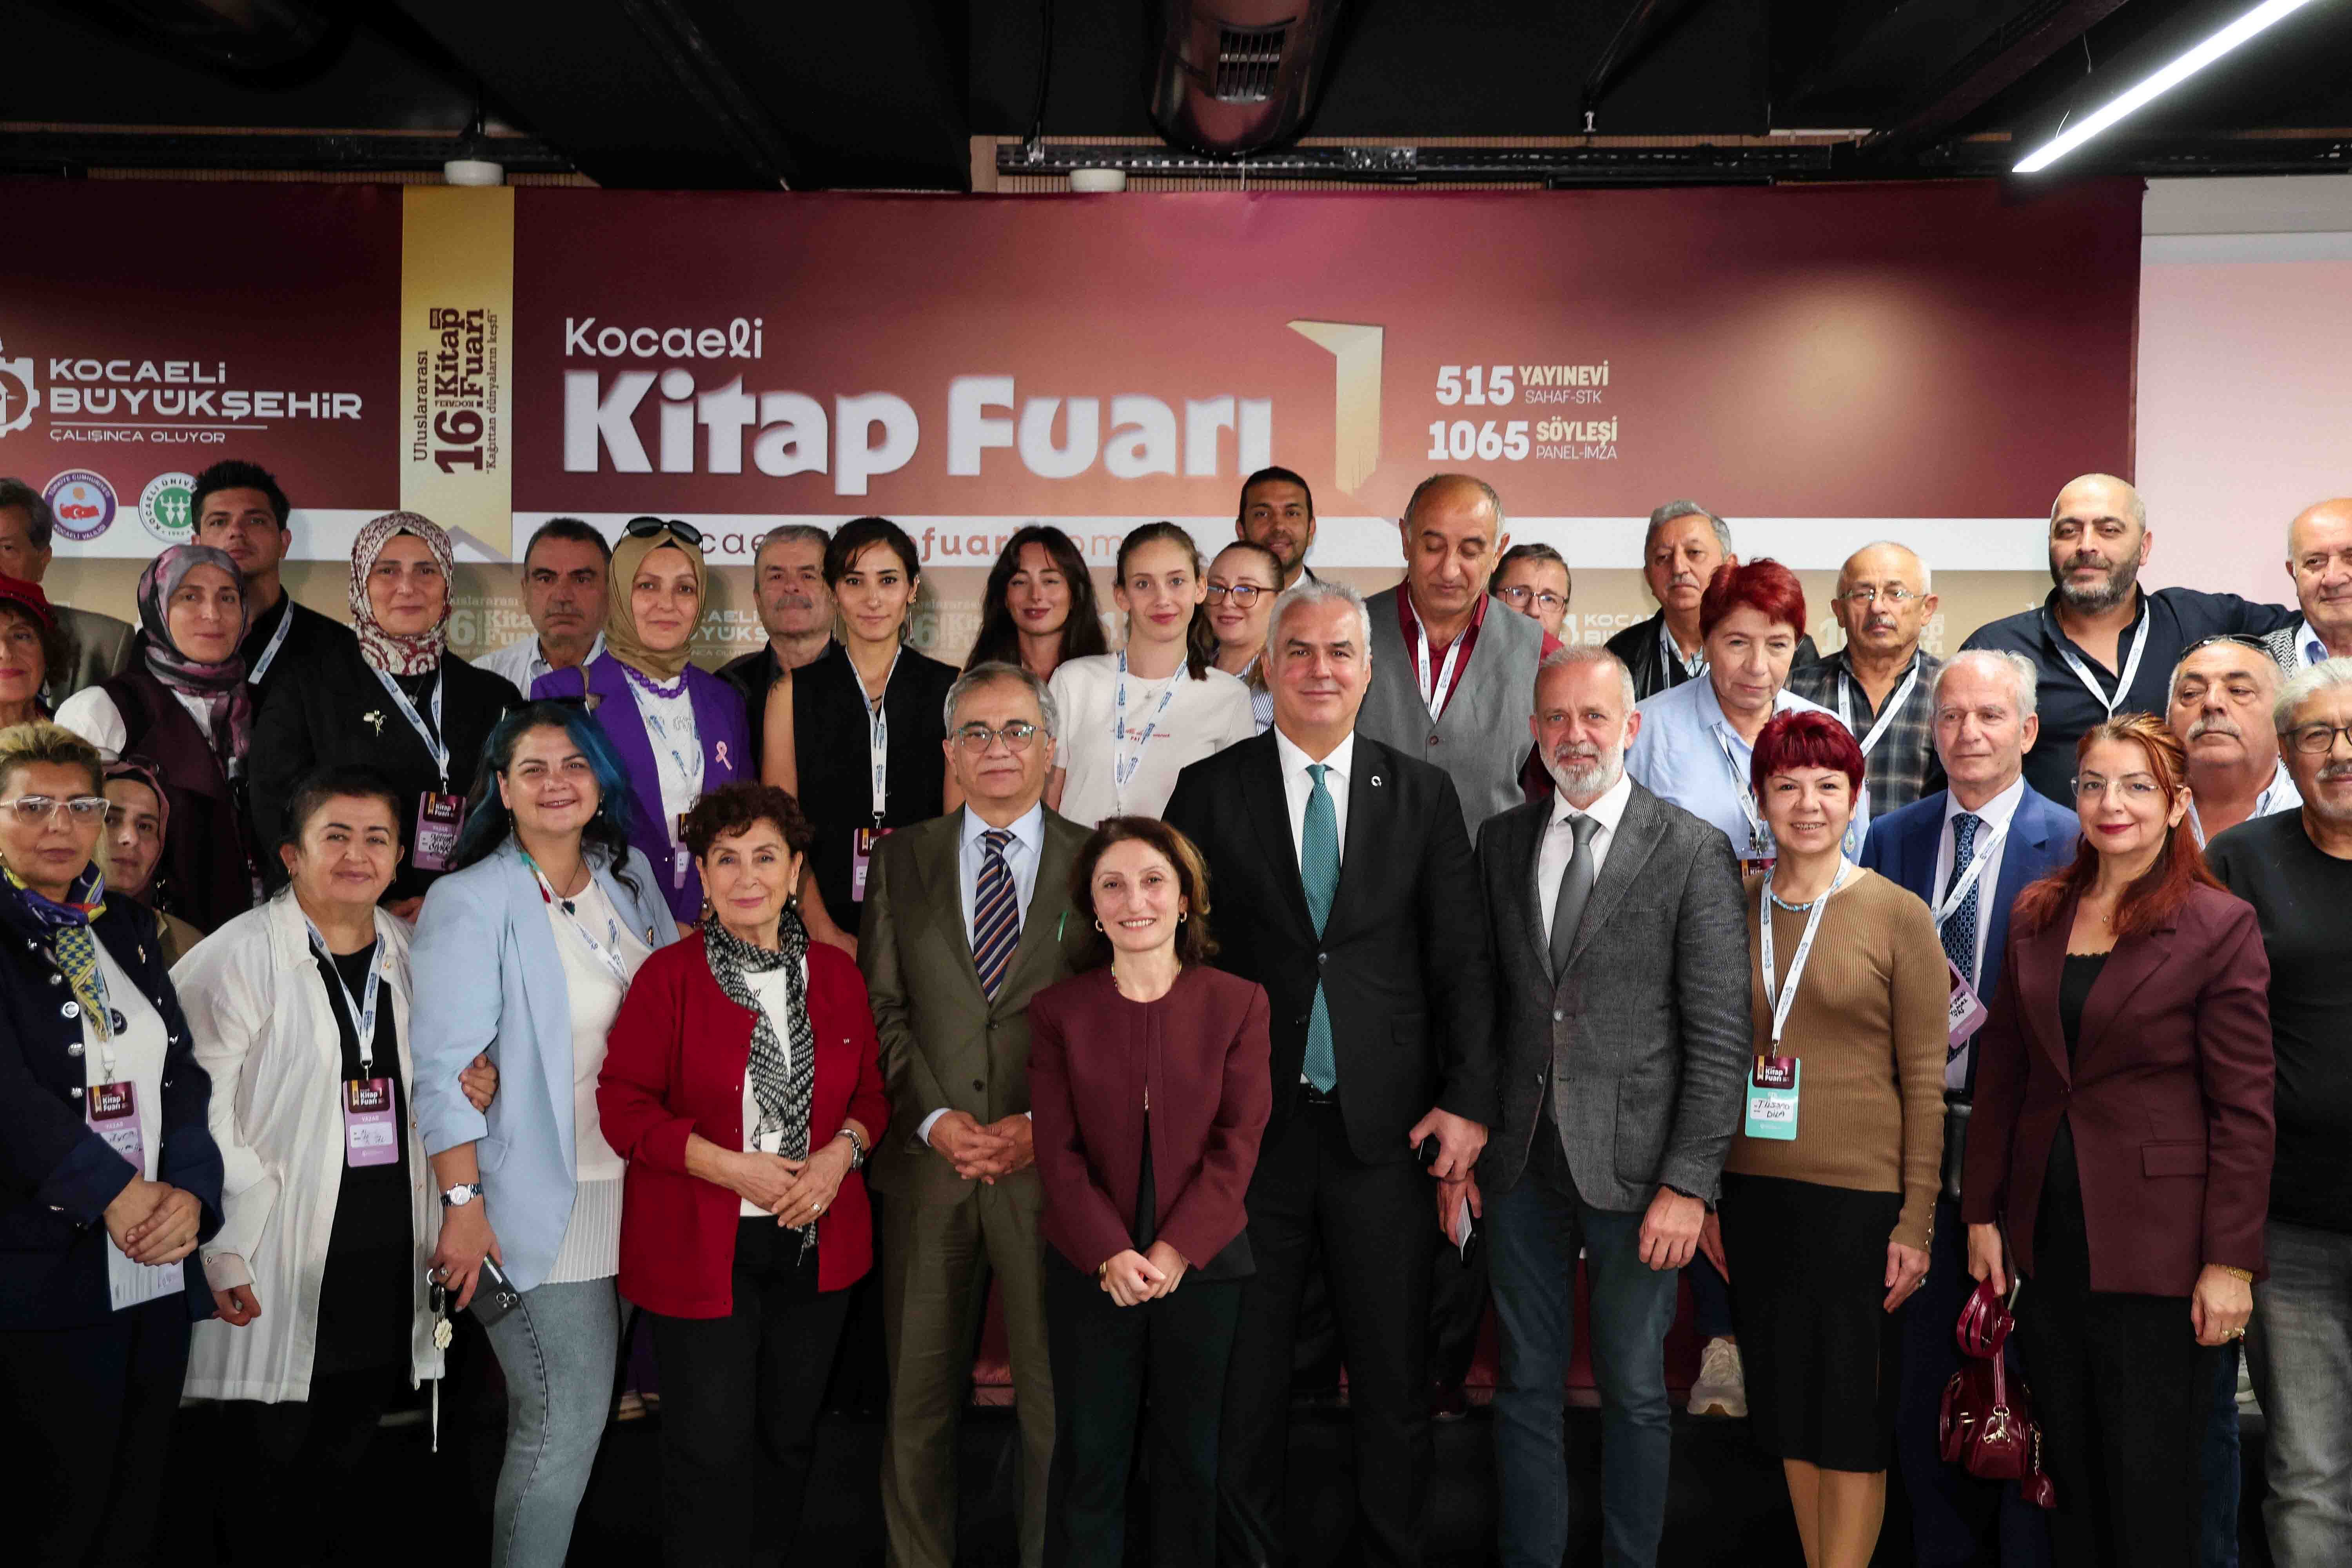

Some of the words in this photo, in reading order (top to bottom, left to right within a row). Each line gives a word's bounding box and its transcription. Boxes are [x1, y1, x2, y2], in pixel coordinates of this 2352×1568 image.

[435, 308, 465, 398] Kitap
[460, 309, 483, 398] Fuarı
[566, 318, 762, 358] Kocaeli
[1436, 365, 1515, 406] 515
[1519, 360, 1609, 386] YAYINEVİ
[1524, 389, 1602, 405] SAHAF-STK
[414, 350, 428, 462] Uluslararası
[49, 429, 144, 443] ÇALIŞINCA
[151, 430, 226, 443] OLUYOR
[564, 368, 919, 495] Kitap
[947, 376, 1272, 478] Fuarı
[1428, 420, 1530, 461] 1065
[1536, 416, 1618, 448] SÖYLEŞİ
[1536, 442, 1617, 459] PANEL-İMZA
